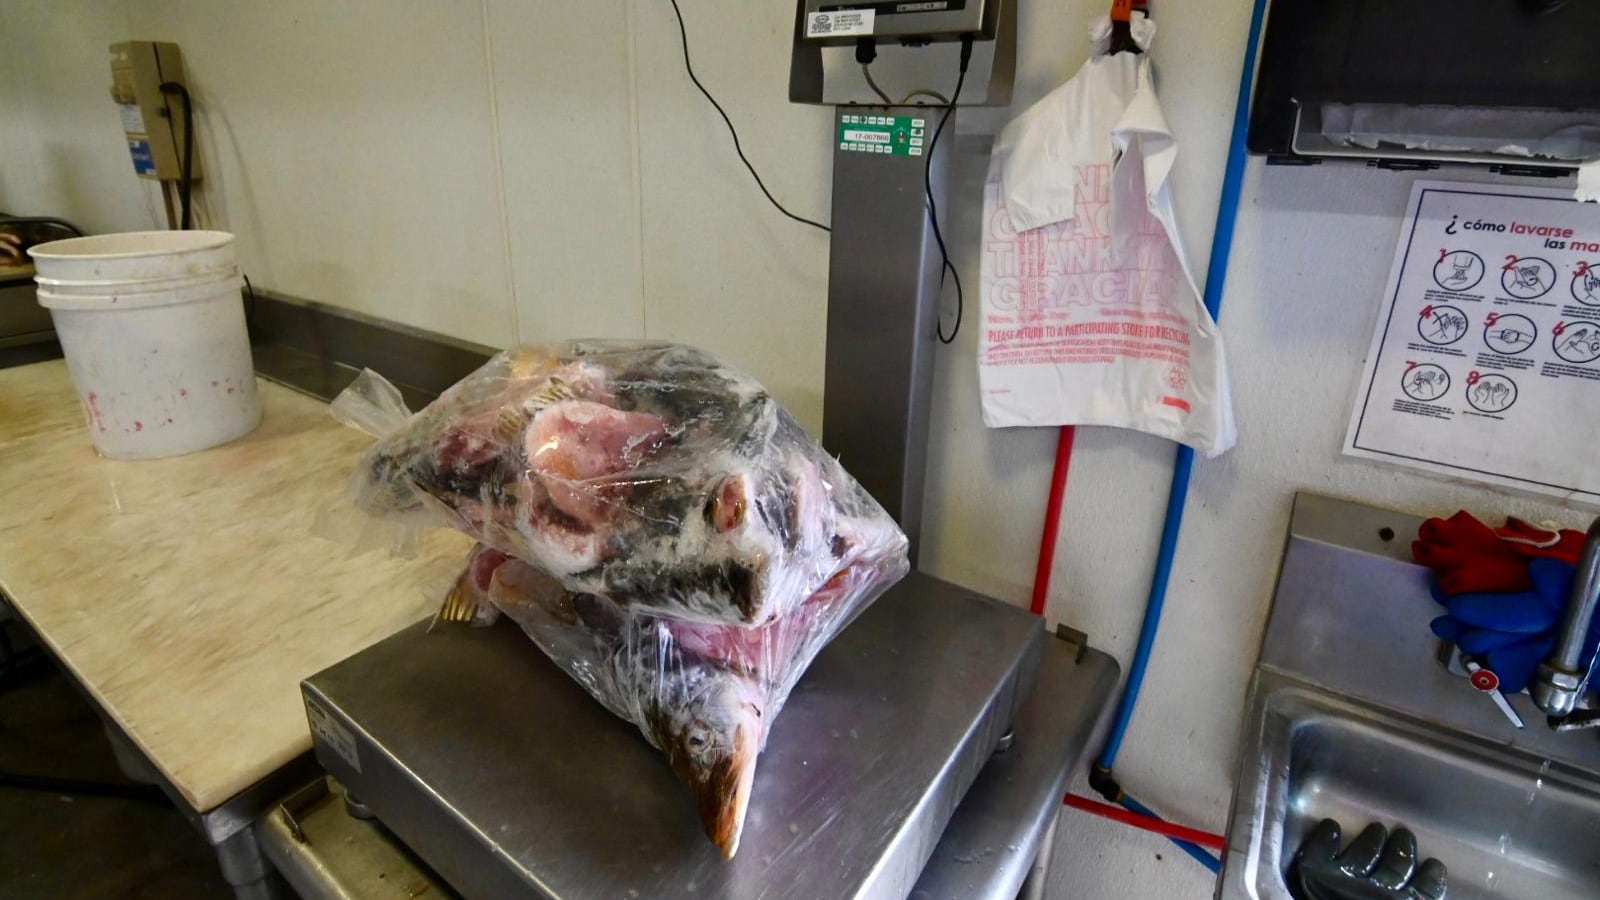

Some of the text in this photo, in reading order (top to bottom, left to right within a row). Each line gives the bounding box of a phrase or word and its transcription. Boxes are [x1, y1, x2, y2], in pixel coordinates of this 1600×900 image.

[1463, 219, 1506, 233] cómo
[1510, 221, 1574, 238] lavarse
[1544, 238, 1600, 252] las ma
[1439, 249, 1447, 263] 1
[1502, 254, 1518, 270] 2
[1573, 260, 1588, 276] 3
[1419, 305, 1433, 319] 4
[1484, 312, 1498, 327] 5
[1046, 325, 1055, 337] TO
[1552, 321, 1564, 336] 6
[1405, 361, 1417, 371] 7
[1466, 371, 1480, 385] 8
